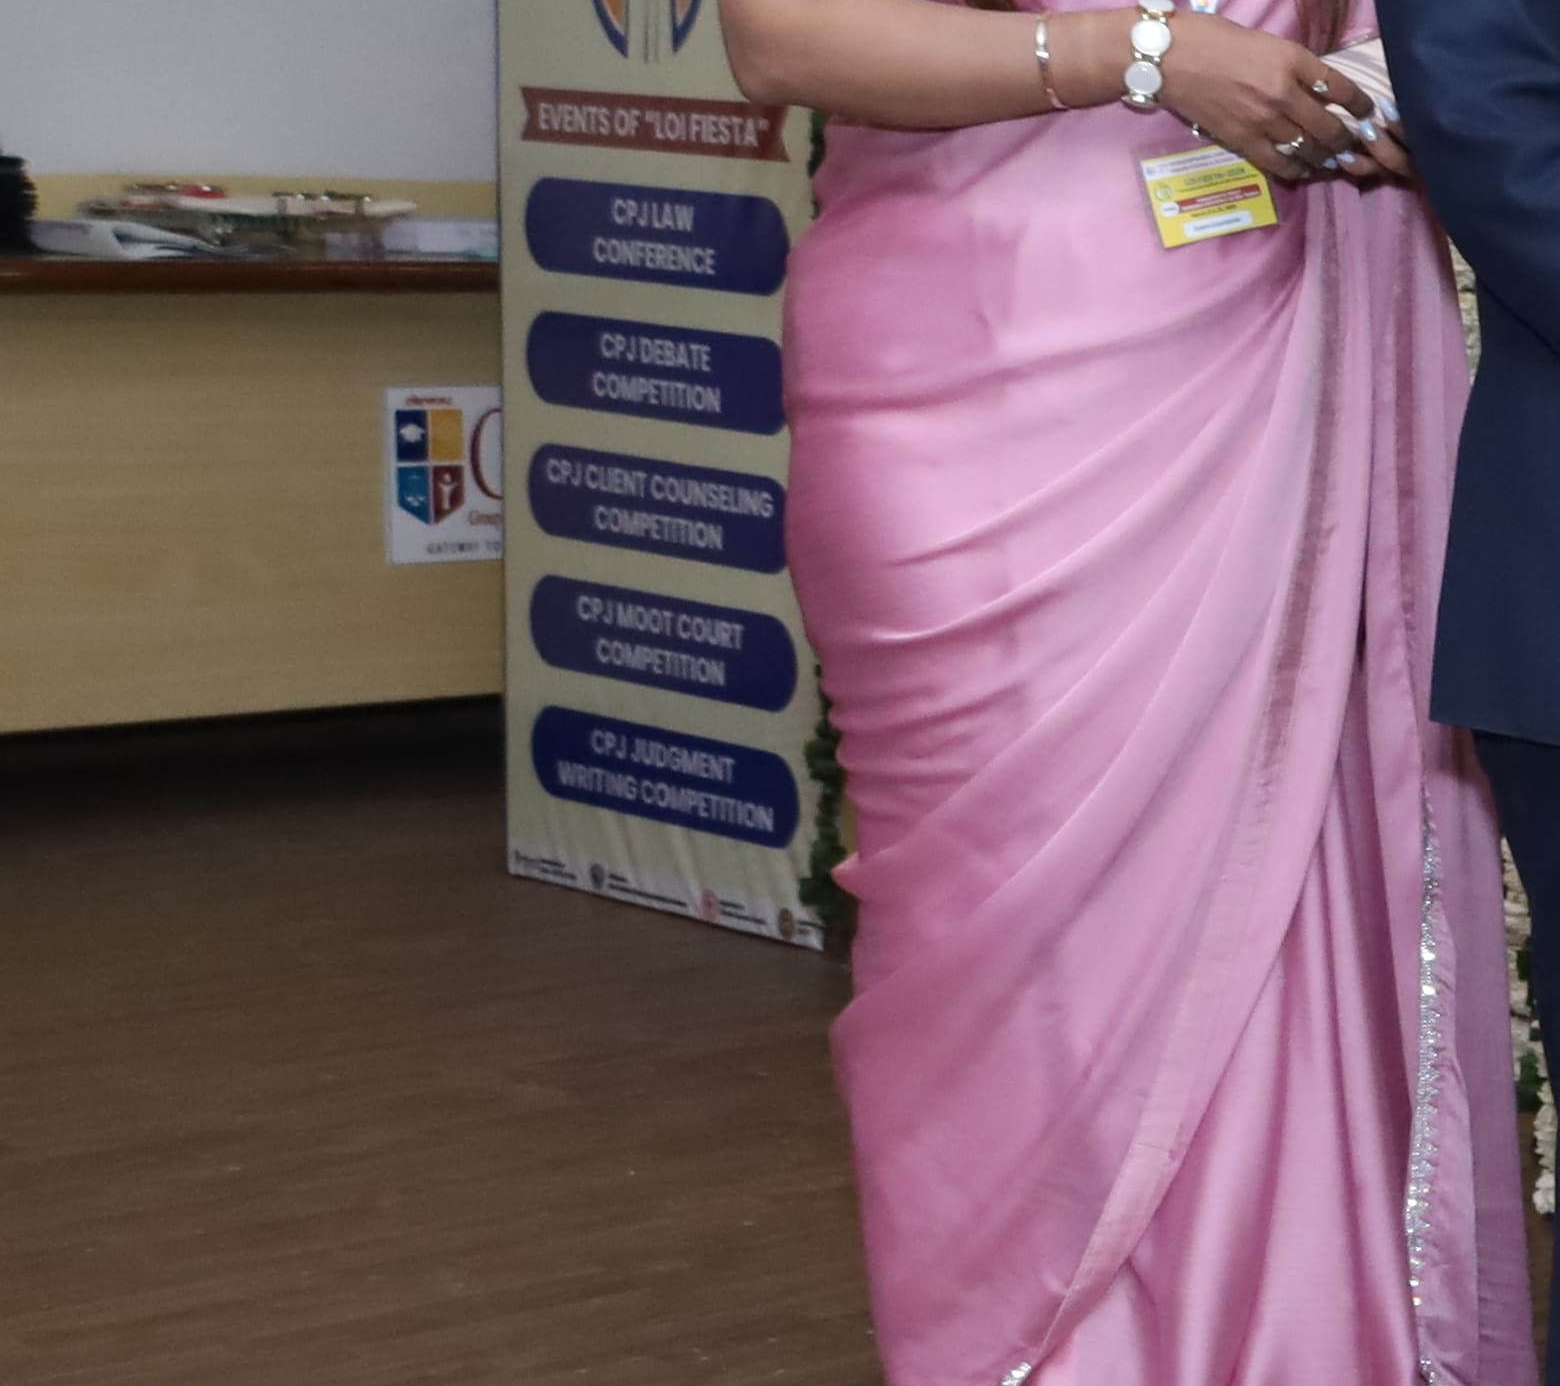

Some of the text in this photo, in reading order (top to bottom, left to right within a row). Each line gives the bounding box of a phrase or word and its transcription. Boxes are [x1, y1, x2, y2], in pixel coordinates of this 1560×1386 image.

[538, 102, 610, 134] EVENTS
[614, 107, 641, 136] OF
[612, 198, 696, 232] CPJ LAW
[593, 237, 716, 275] CONFERENCE
[600, 332, 711, 372] CPJ DEBATE
[593, 372, 722, 413] COMPETITION
[547, 458, 774, 518] CPJ CLIENT COUNSELING
[594, 506, 723, 551] COMPETITION
[577, 595, 744, 650] CPJ MOOT COURT
[596, 637, 726, 687] COMPETITION
[591, 730, 735, 784] CPJ JUDGMENT
[558, 760, 774, 832] WRITING COMPETITION
